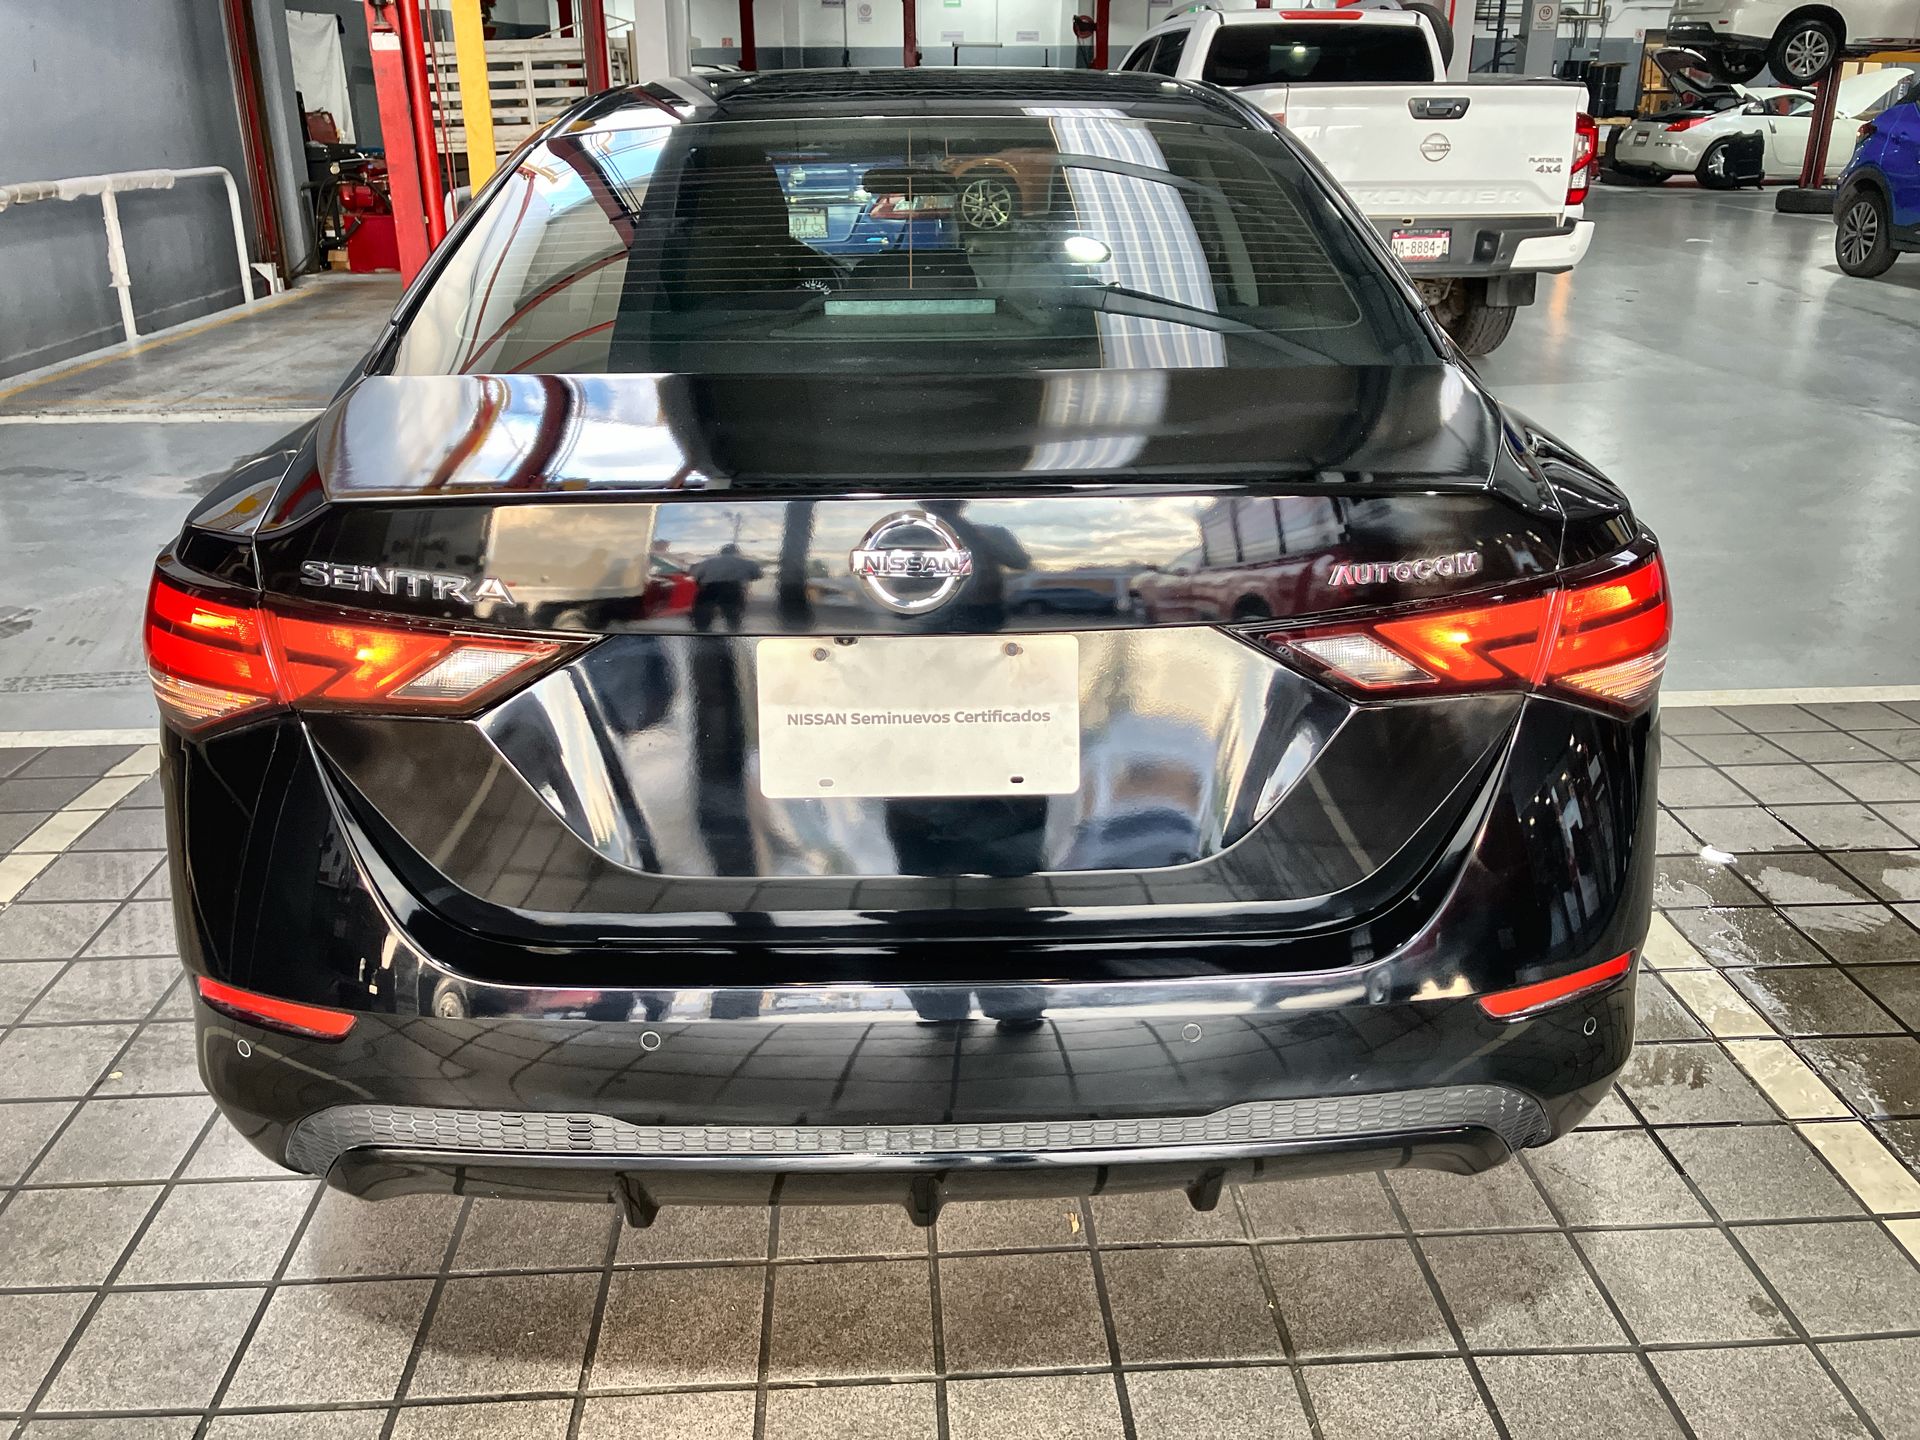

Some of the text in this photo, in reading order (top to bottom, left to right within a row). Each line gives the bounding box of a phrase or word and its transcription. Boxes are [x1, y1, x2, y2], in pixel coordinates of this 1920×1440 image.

[1535, 164, 1562, 174] 4x4
[863, 555, 960, 574] NISSAN
[1328, 552, 1479, 586] AUTOCOM
[300, 560, 516, 606] SENTRA
[787, 709, 1051, 726] NISSAN Seminuevos Certificados
